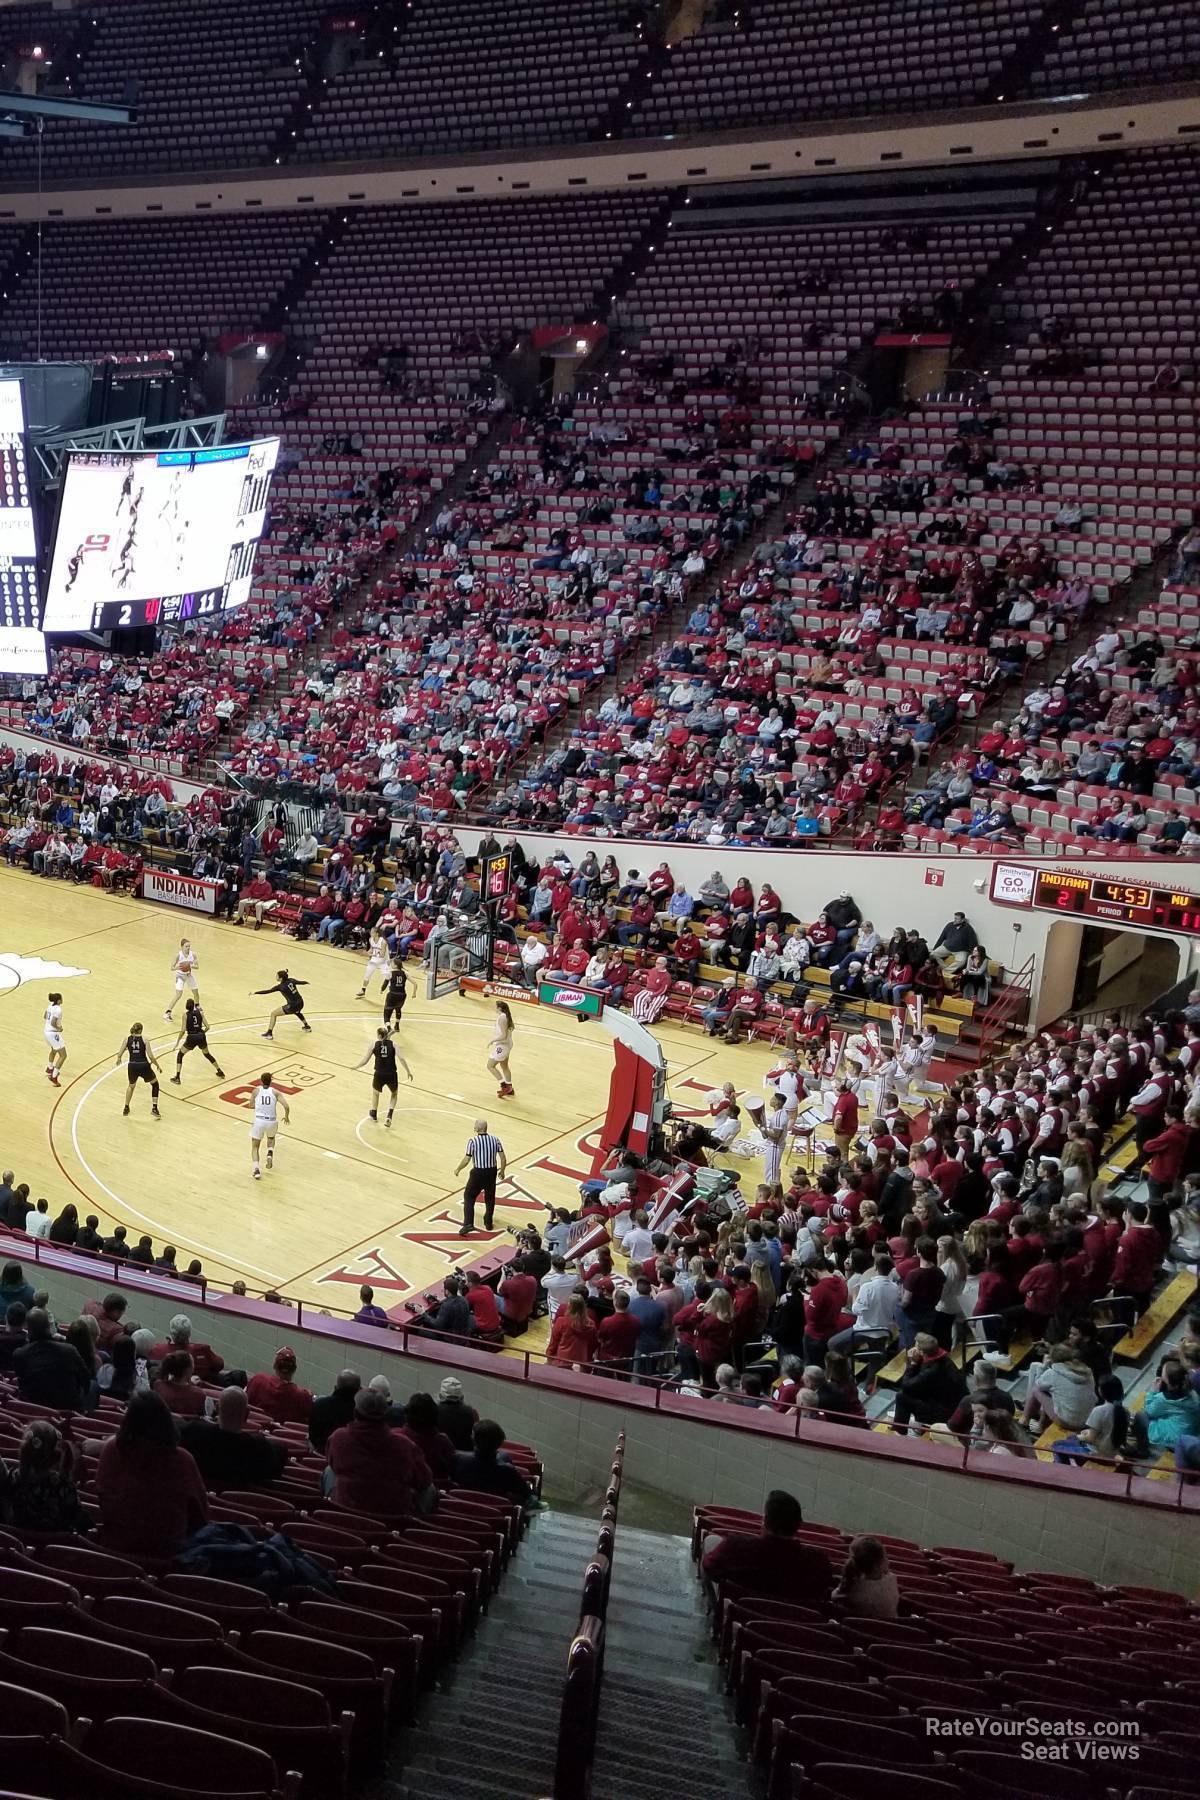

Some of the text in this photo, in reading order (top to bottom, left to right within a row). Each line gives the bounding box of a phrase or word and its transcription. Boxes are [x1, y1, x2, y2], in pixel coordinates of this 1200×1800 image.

[162, 596, 181, 608] 4:54
[181, 594, 195, 617] N
[198, 592, 216, 614] 11
[118, 605, 132, 625] 2
[491, 857, 507, 871] 4:53
[1000, 867, 1032, 877] Smithville
[490, 871, 503, 893] 16
[931, 874, 938, 884] 9
[1003, 877, 1023, 887] GO
[1040, 873, 1089, 890] INDIANA
[1056, 866, 1191, 893] SIMON SKJODT ASSEMBLY HALL
[152, 875, 206, 901] INDIANA
[1001, 886, 1027, 894] TEAM!
[157, 890, 199, 908] BASKETBALL
[1057, 891, 1069, 906] 2
[1107, 886, 1148, 906] 4:53
[1171, 894, 1189, 906] NU
[1097, 906, 1122, 916] PERIOD
[554, 990, 583, 1002] LIBMAN
[192, 1015, 198, 1025] 3
[131, 1041, 140, 1049] 44
[261, 1095, 271, 1106] 10
